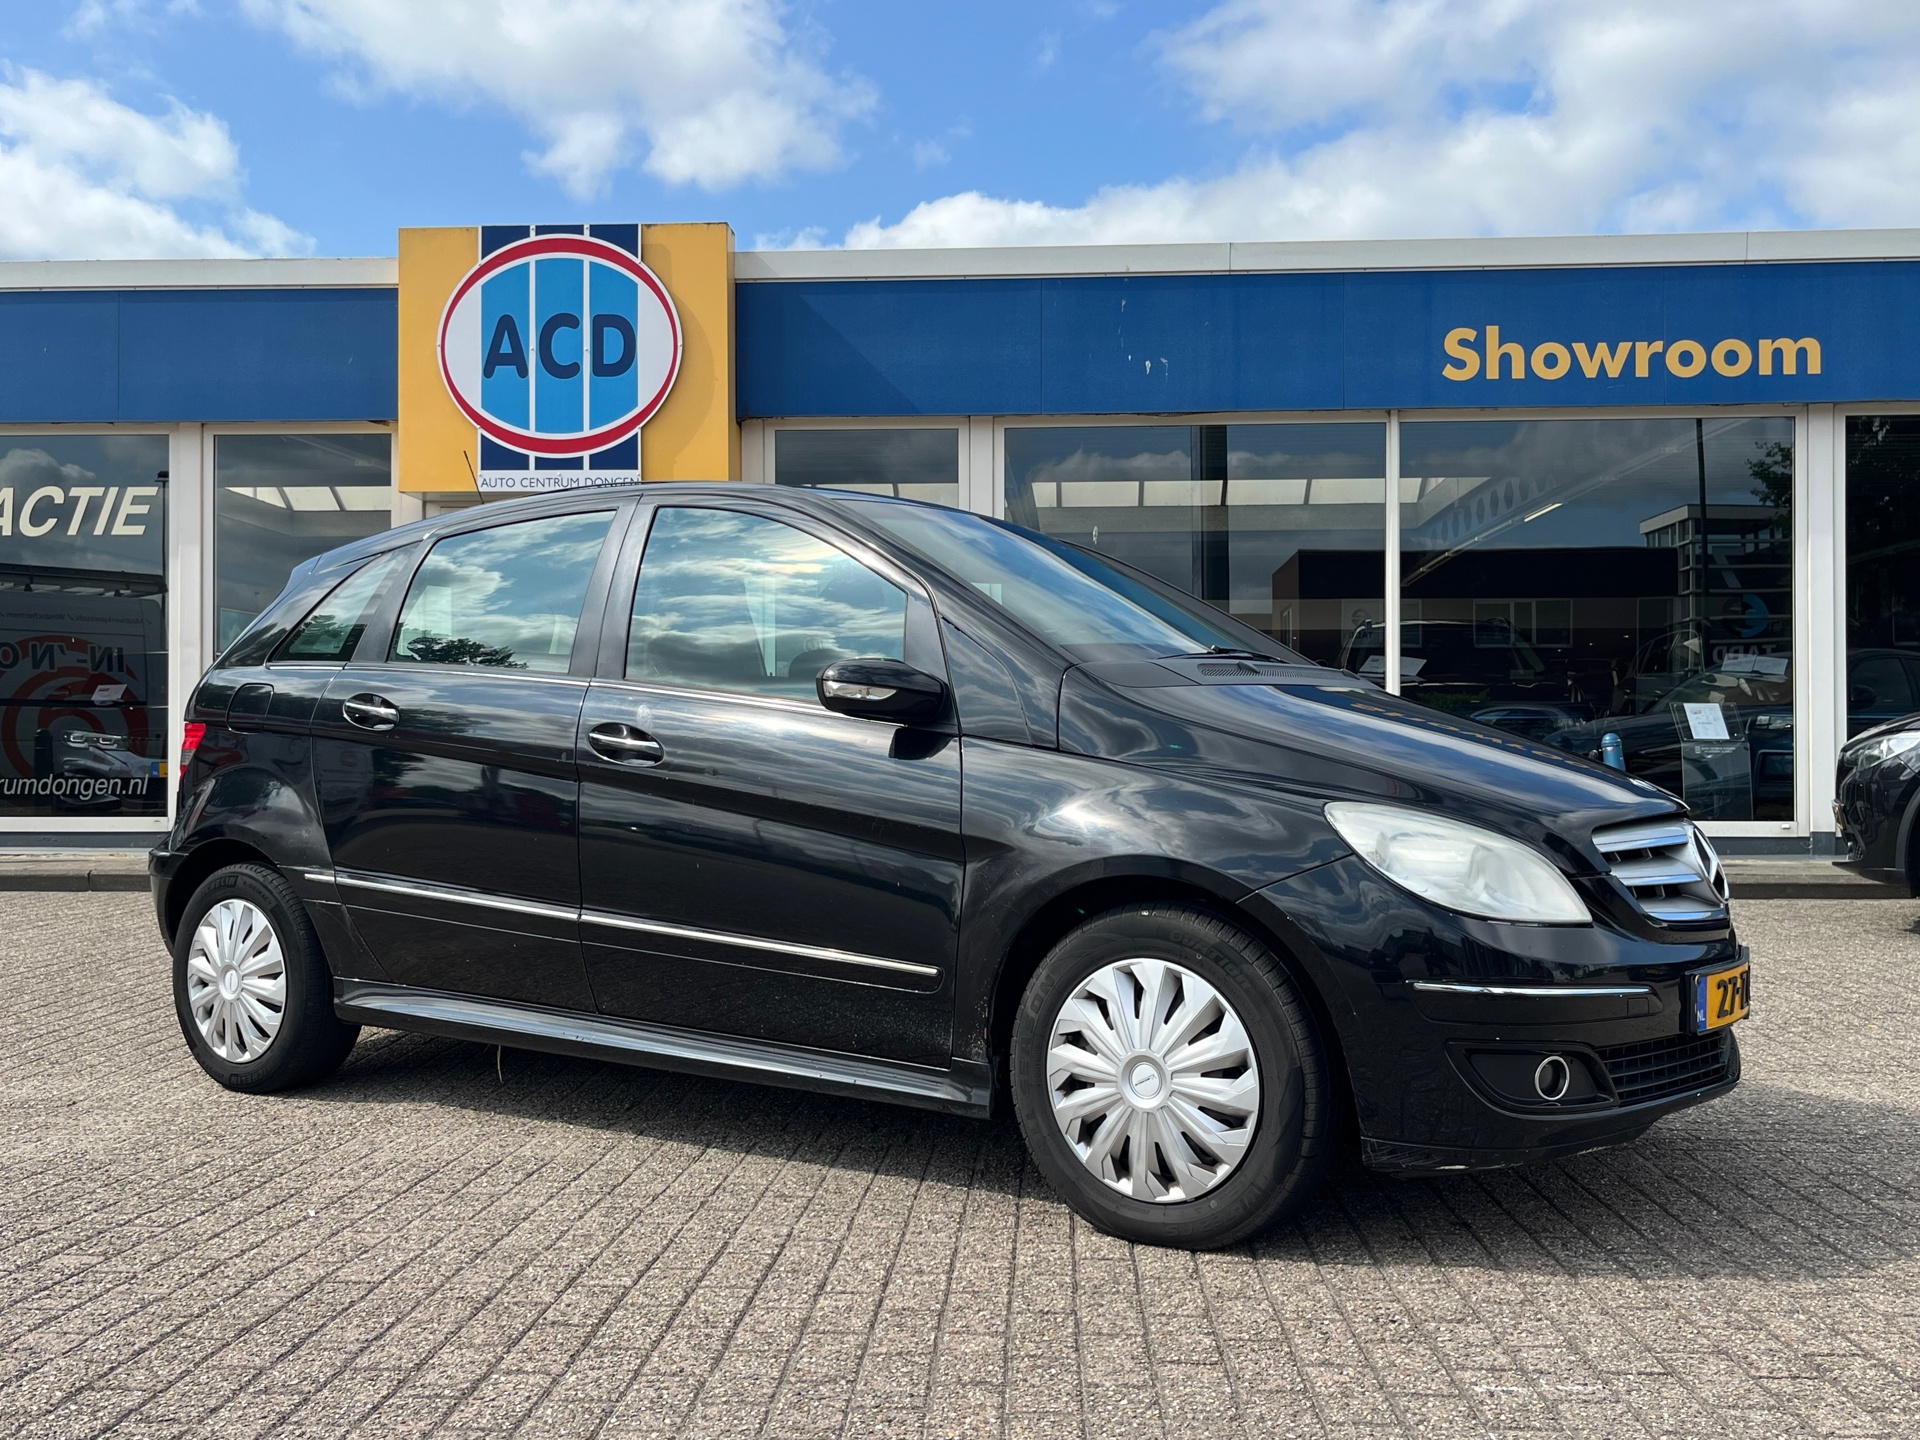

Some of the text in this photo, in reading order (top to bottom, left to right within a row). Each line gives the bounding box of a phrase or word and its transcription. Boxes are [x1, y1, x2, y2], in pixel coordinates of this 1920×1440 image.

[483, 313, 637, 380] ACD
[1442, 325, 1822, 381] Showroom
[480, 477, 516, 488] AUTO
[520, 477, 580, 488] CENTRUM
[1697, 1009, 1706, 1022] NL
